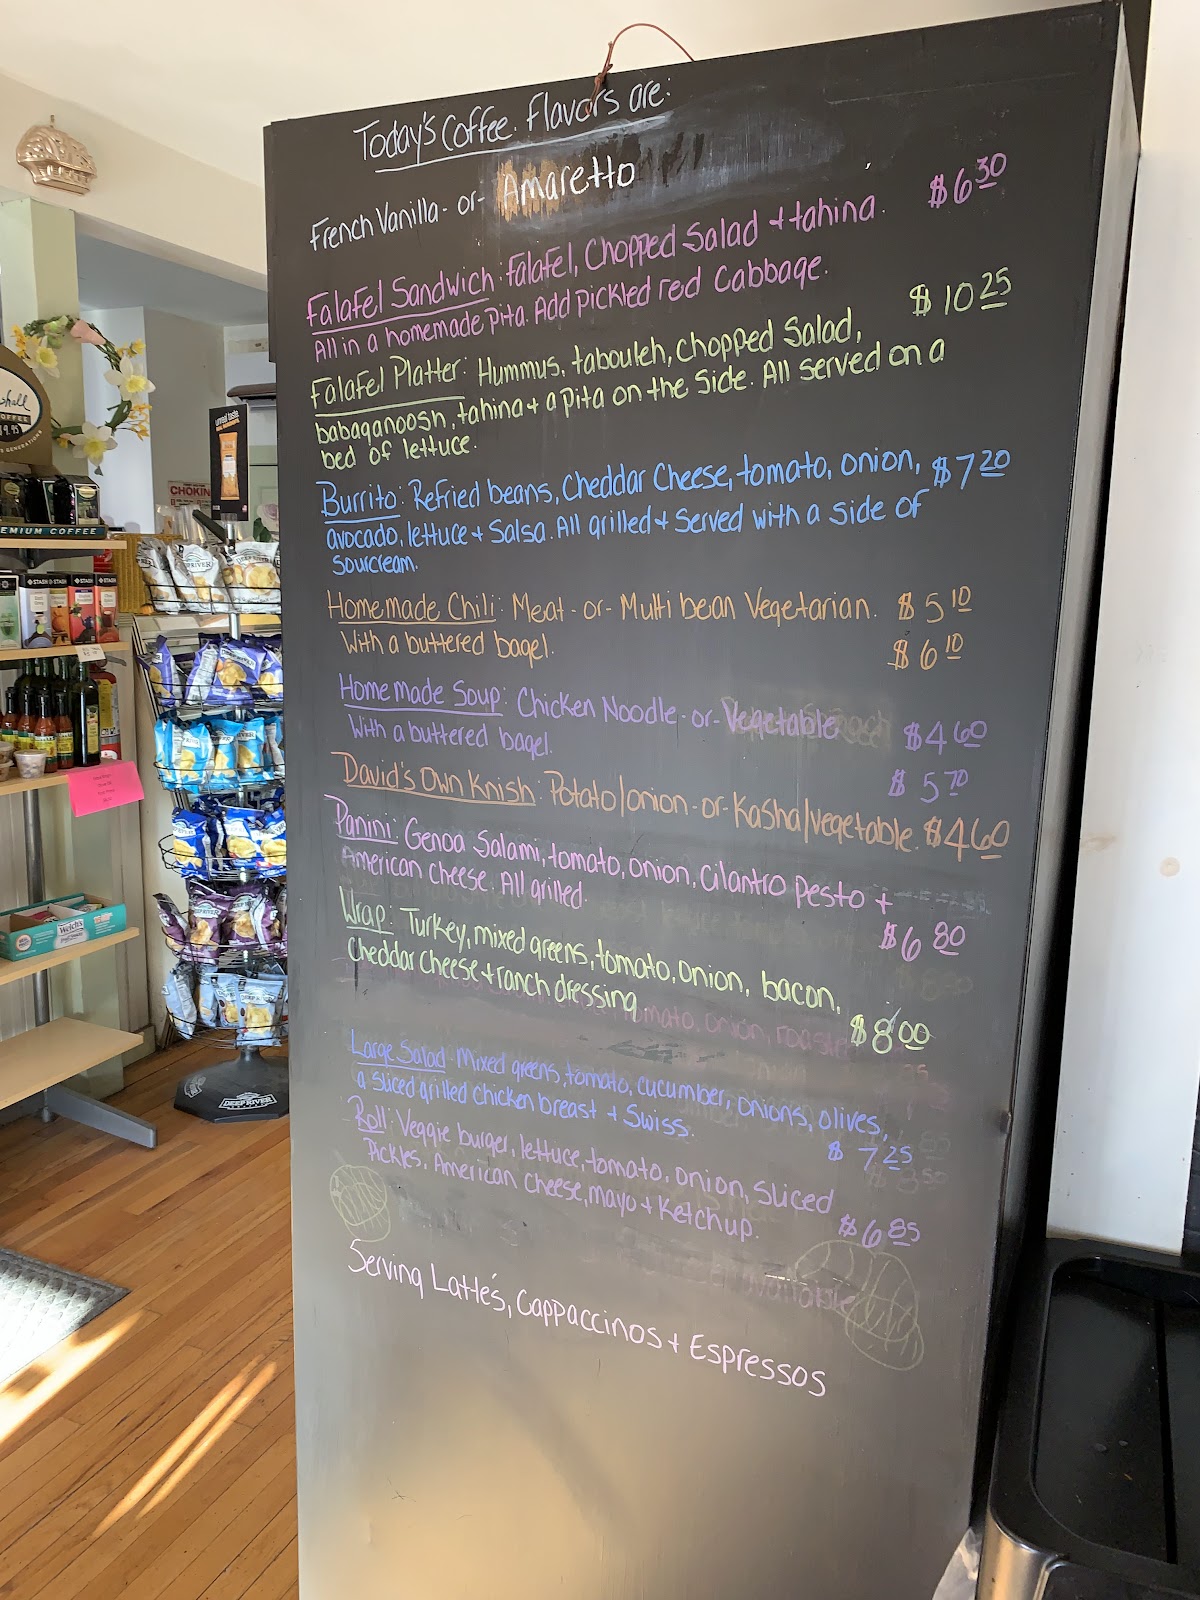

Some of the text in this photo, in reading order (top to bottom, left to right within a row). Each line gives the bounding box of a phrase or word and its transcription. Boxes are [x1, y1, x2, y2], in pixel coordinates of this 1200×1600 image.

[353, 111, 435, 164] Today's
[527, 90, 619, 132] Flavors
[310, 217, 373, 251] French
[502, 155, 635, 209] Amaretto
[306, 279, 383, 326] Falafel
[506, 242, 578, 286] Falafel,
[584, 223, 676, 270] Chopped
[683, 209, 758, 253] Salad
[315, 337, 337, 362] All
[341, 336, 360, 355] in
[367, 333, 379, 353] a
[385, 311, 484, 347] homemade
[535, 289, 570, 324] Add
[576, 276, 651, 319] pickled
[658, 266, 701, 302] red
[310, 366, 384, 409] Falafel
[572, 335, 672, 376] tabouleh,
[315, 410, 455, 445] babaganoosh,
[457, 398, 523, 425] tahina
[546, 391, 557, 412] a
[612, 384, 642, 407] on
[646, 376, 689, 402] the
[762, 358, 790, 389] All
[889, 343, 922, 368] on
[1, 414, 28, 423] OFFEE
[315, 447, 921, 518] Burrito: Refried beans, Cheddar Cheese, tomato, onion,
[320, 435, 477, 470] bed of lettuce.
[50, 527, 97, 535] COFFEE
[326, 524, 404, 550] avocado,
[407, 521, 469, 548] lettuce
[557, 514, 580, 539] All
[588, 505, 651, 540] grilled
[752, 502, 800, 531] with
[806, 503, 821, 525] a
[895, 488, 930, 519] of
[512, 592, 564, 623] Meat
[620, 591, 672, 621] Multi
[680, 591, 737, 621] bean
[340, 630, 555, 668] With a buttered bagel.
[348, 714, 554, 760] With buttered bagel.
[517, 687, 596, 719] Chicken
[602, 696, 677, 725] Noodle
[721, 699, 840, 741] Vegetable
[330, 751, 415, 791] David's
[420, 767, 463, 797] Own
[341, 846, 422, 879] American
[501, 873, 524, 898] All
[531, 877, 587, 910] grilled.
[405, 818, 466, 853] Genoa
[473, 830, 546, 867] Salami,
[548, 843, 625, 879] tomato,
[628, 857, 697, 889] onion,
[700, 860, 786, 897] Cilantro
[59, 919, 84, 934] Welch's
[348, 936, 414, 971] Cheddar
[496, 965, 550, 997] ranch
[400, 907, 472, 953] Turkey,
[474, 923, 526, 954] mixed
[530, 934, 595, 971] greens,
[595, 938, 676, 984] tomato,
[678, 959, 750, 998] onion,
[762, 970, 841, 1015] bacon,
[223, 1096, 274, 1107] DEEP RIVER
[351, 1028, 394, 1064] Large
[456, 1048, 505, 1075] Mixed
[511, 1059, 567, 1088] greens,
[566, 1060, 633, 1097] tomato,
[637, 1075, 731, 1110] cucumber,
[738, 1096, 813, 1132] onions,
[819, 1107, 888, 1142] olives,
[357, 1070, 366, 1089] a
[419, 1077, 467, 1105] grilled
[538, 1091, 597, 1120] breast
[396, 1108, 451, 1143] Veggie
[457, 1122, 516, 1158] burger,
[520, 1134, 585, 1171] lettuce,
[586, 1146, 670, 1183] tomato,
[675, 1165, 749, 1205] onion,
[434, 1152, 517, 1189] American
[588, 1185, 636, 1218] mayo
[347, 1238, 424, 1299] Serving
[516, 1288, 663, 1350] Cappaccinos
[689, 1334, 827, 1397] Espressos
